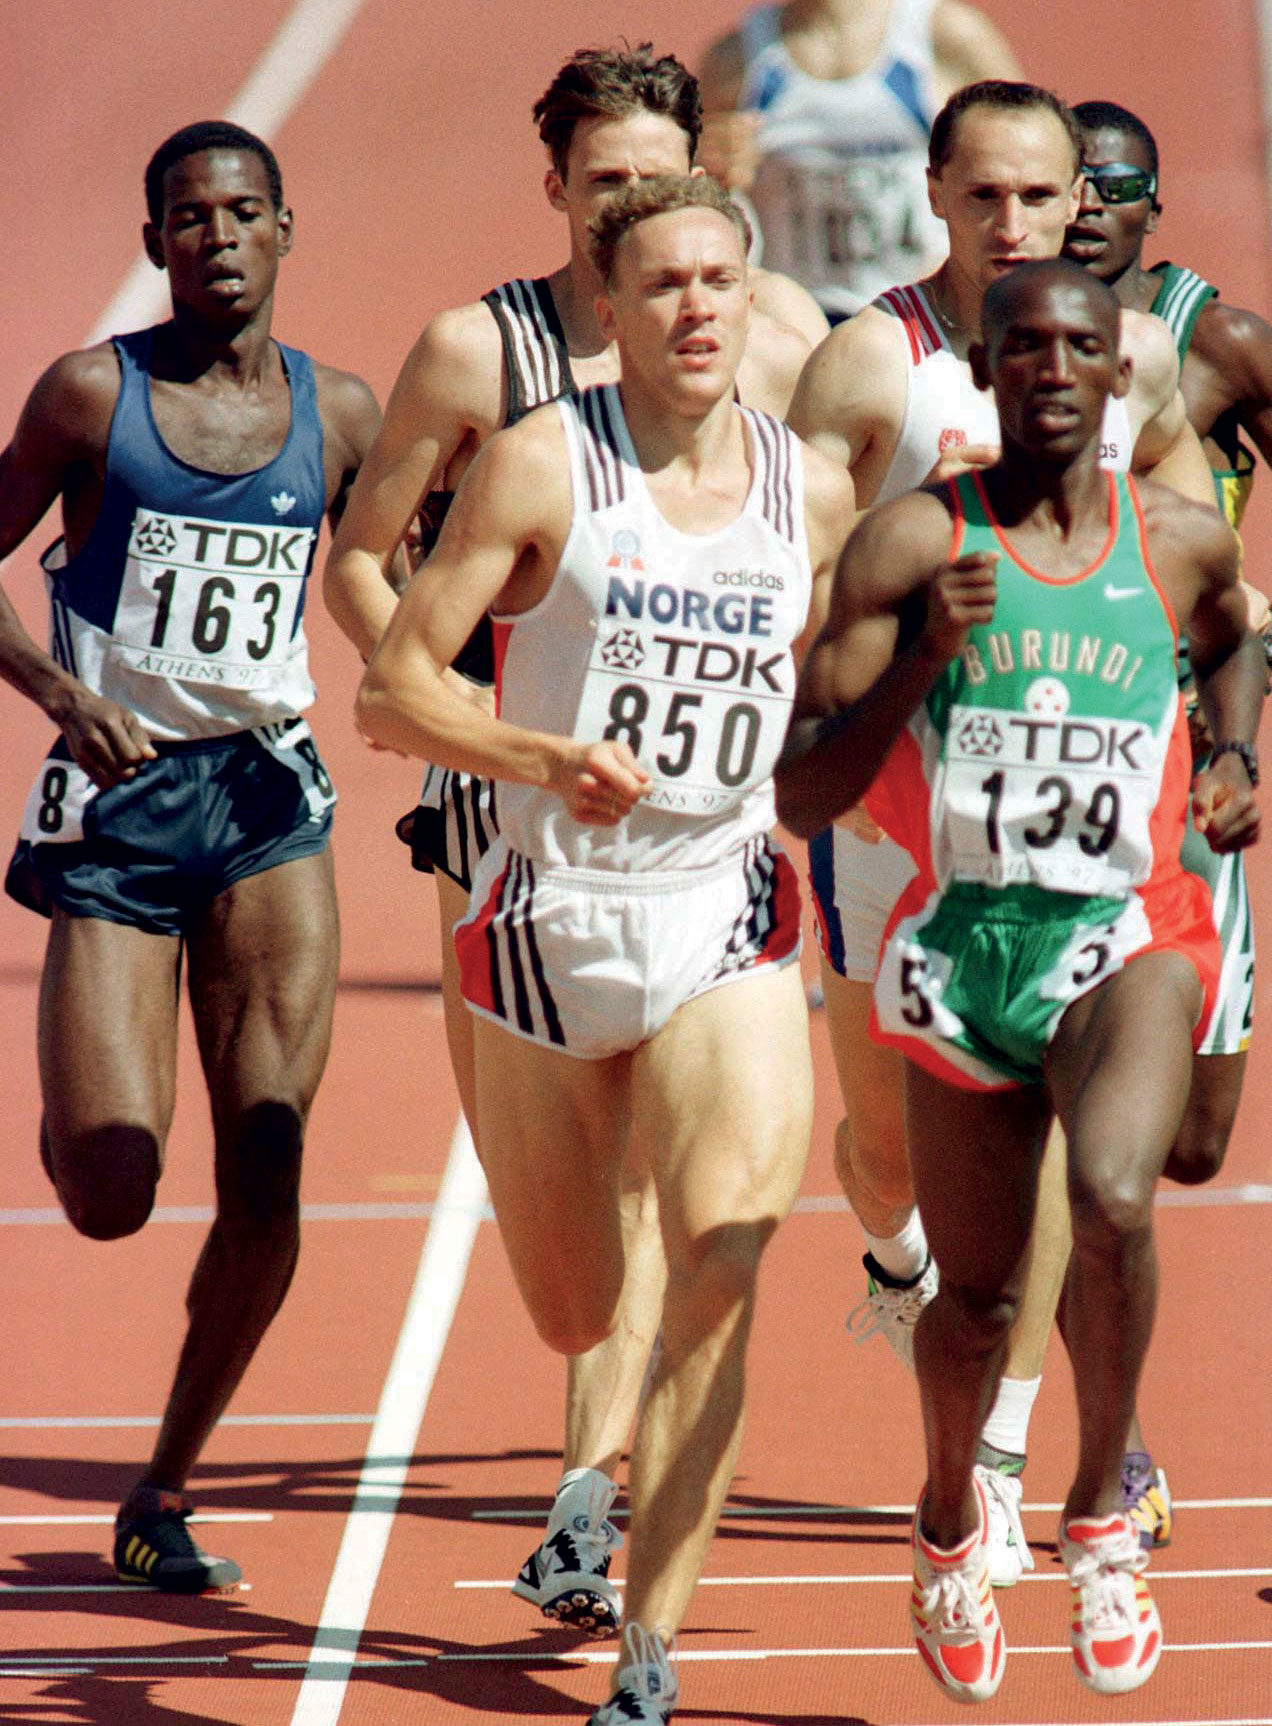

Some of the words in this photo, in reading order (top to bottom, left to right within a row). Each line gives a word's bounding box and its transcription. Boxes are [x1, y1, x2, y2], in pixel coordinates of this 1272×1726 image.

[183, 522, 306, 571] TDK
[605, 576, 774, 637] NORGE
[713, 568, 785, 591] adidas
[149, 569, 281, 661] 163
[136, 654, 225, 681] ATHENS
[654, 635, 786, 693] TDK
[962, 629, 1143, 692] BURUNDI
[603, 683, 762, 787] 850
[1009, 719, 1146, 770] TDK
[38, 766, 68, 833] 8
[981, 771, 1121, 858] 139
[901, 958, 933, 1027] 5
